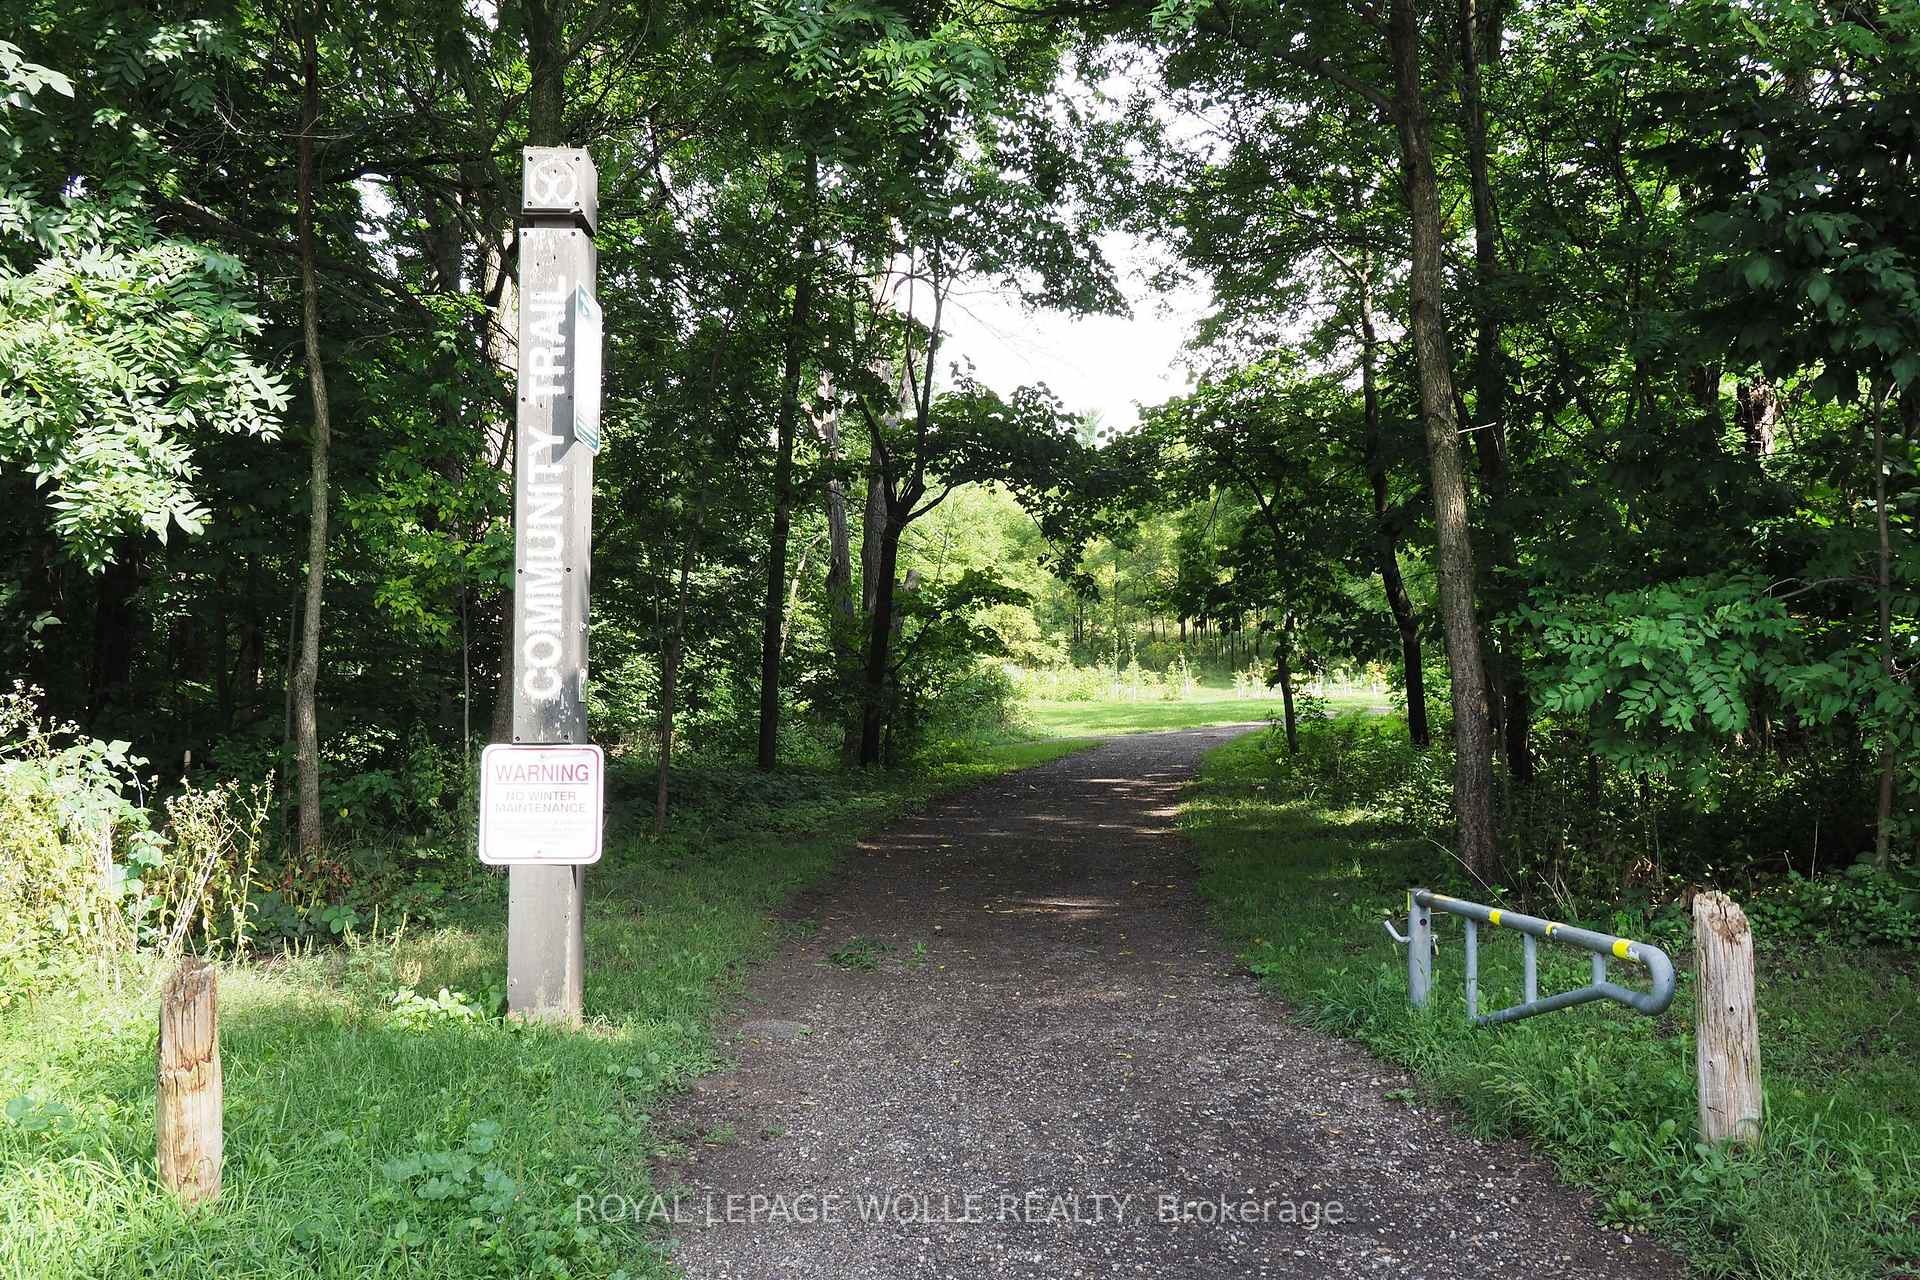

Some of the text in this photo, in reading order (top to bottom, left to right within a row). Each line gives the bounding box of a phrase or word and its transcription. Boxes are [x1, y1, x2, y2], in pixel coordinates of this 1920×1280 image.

[523, 275, 566, 700] COMMUNITY TRAIL
[495, 763, 590, 782] WARNING
[506, 790, 576, 801] NO WINTER
[495, 802, 586, 814] MAINTENANCE
